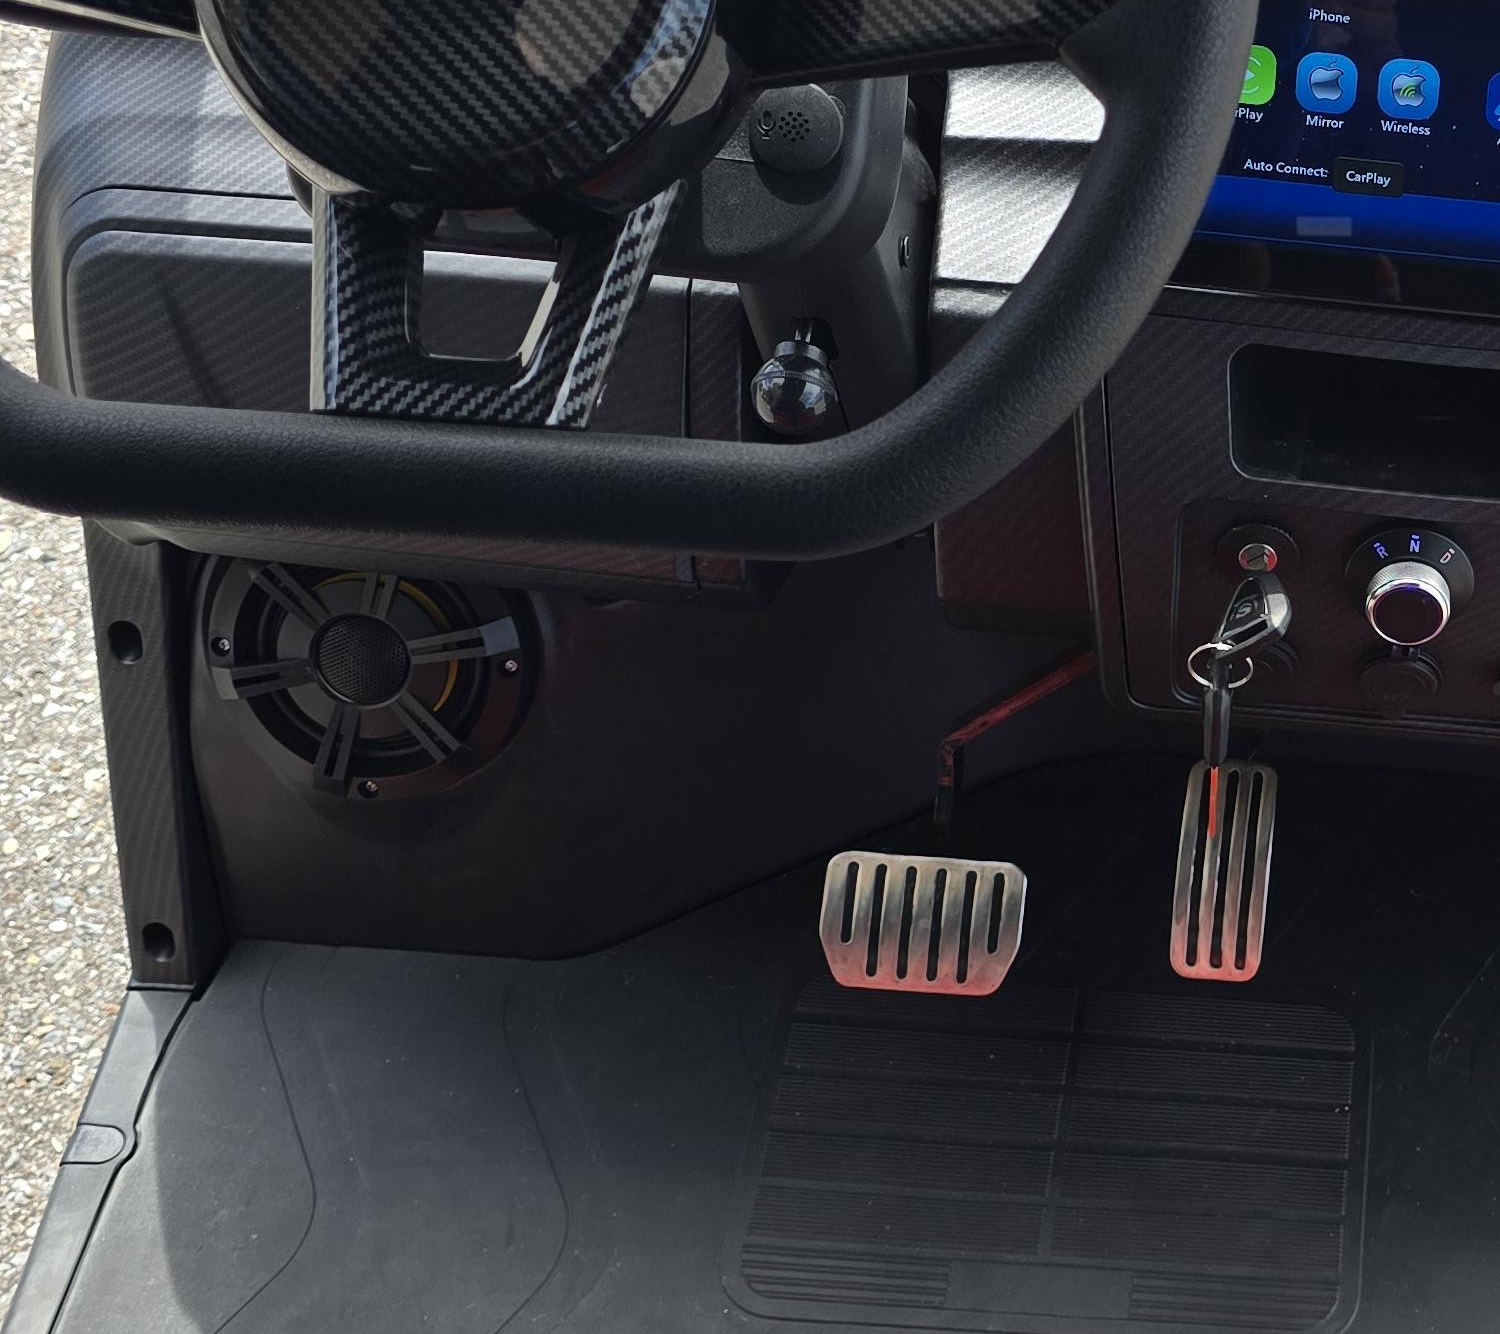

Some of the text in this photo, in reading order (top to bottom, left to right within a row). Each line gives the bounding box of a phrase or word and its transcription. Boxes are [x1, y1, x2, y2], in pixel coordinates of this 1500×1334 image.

[1308, 8, 1351, 25] iPhone
[1305, 113, 1344, 130] Mirror
[1380, 119, 1431, 137] Wireless
[1243, 158, 1329, 178] Auto Connect:
[1345, 170, 1391, 188] CarPlay
[1376, 540, 1452, 564] R N D
